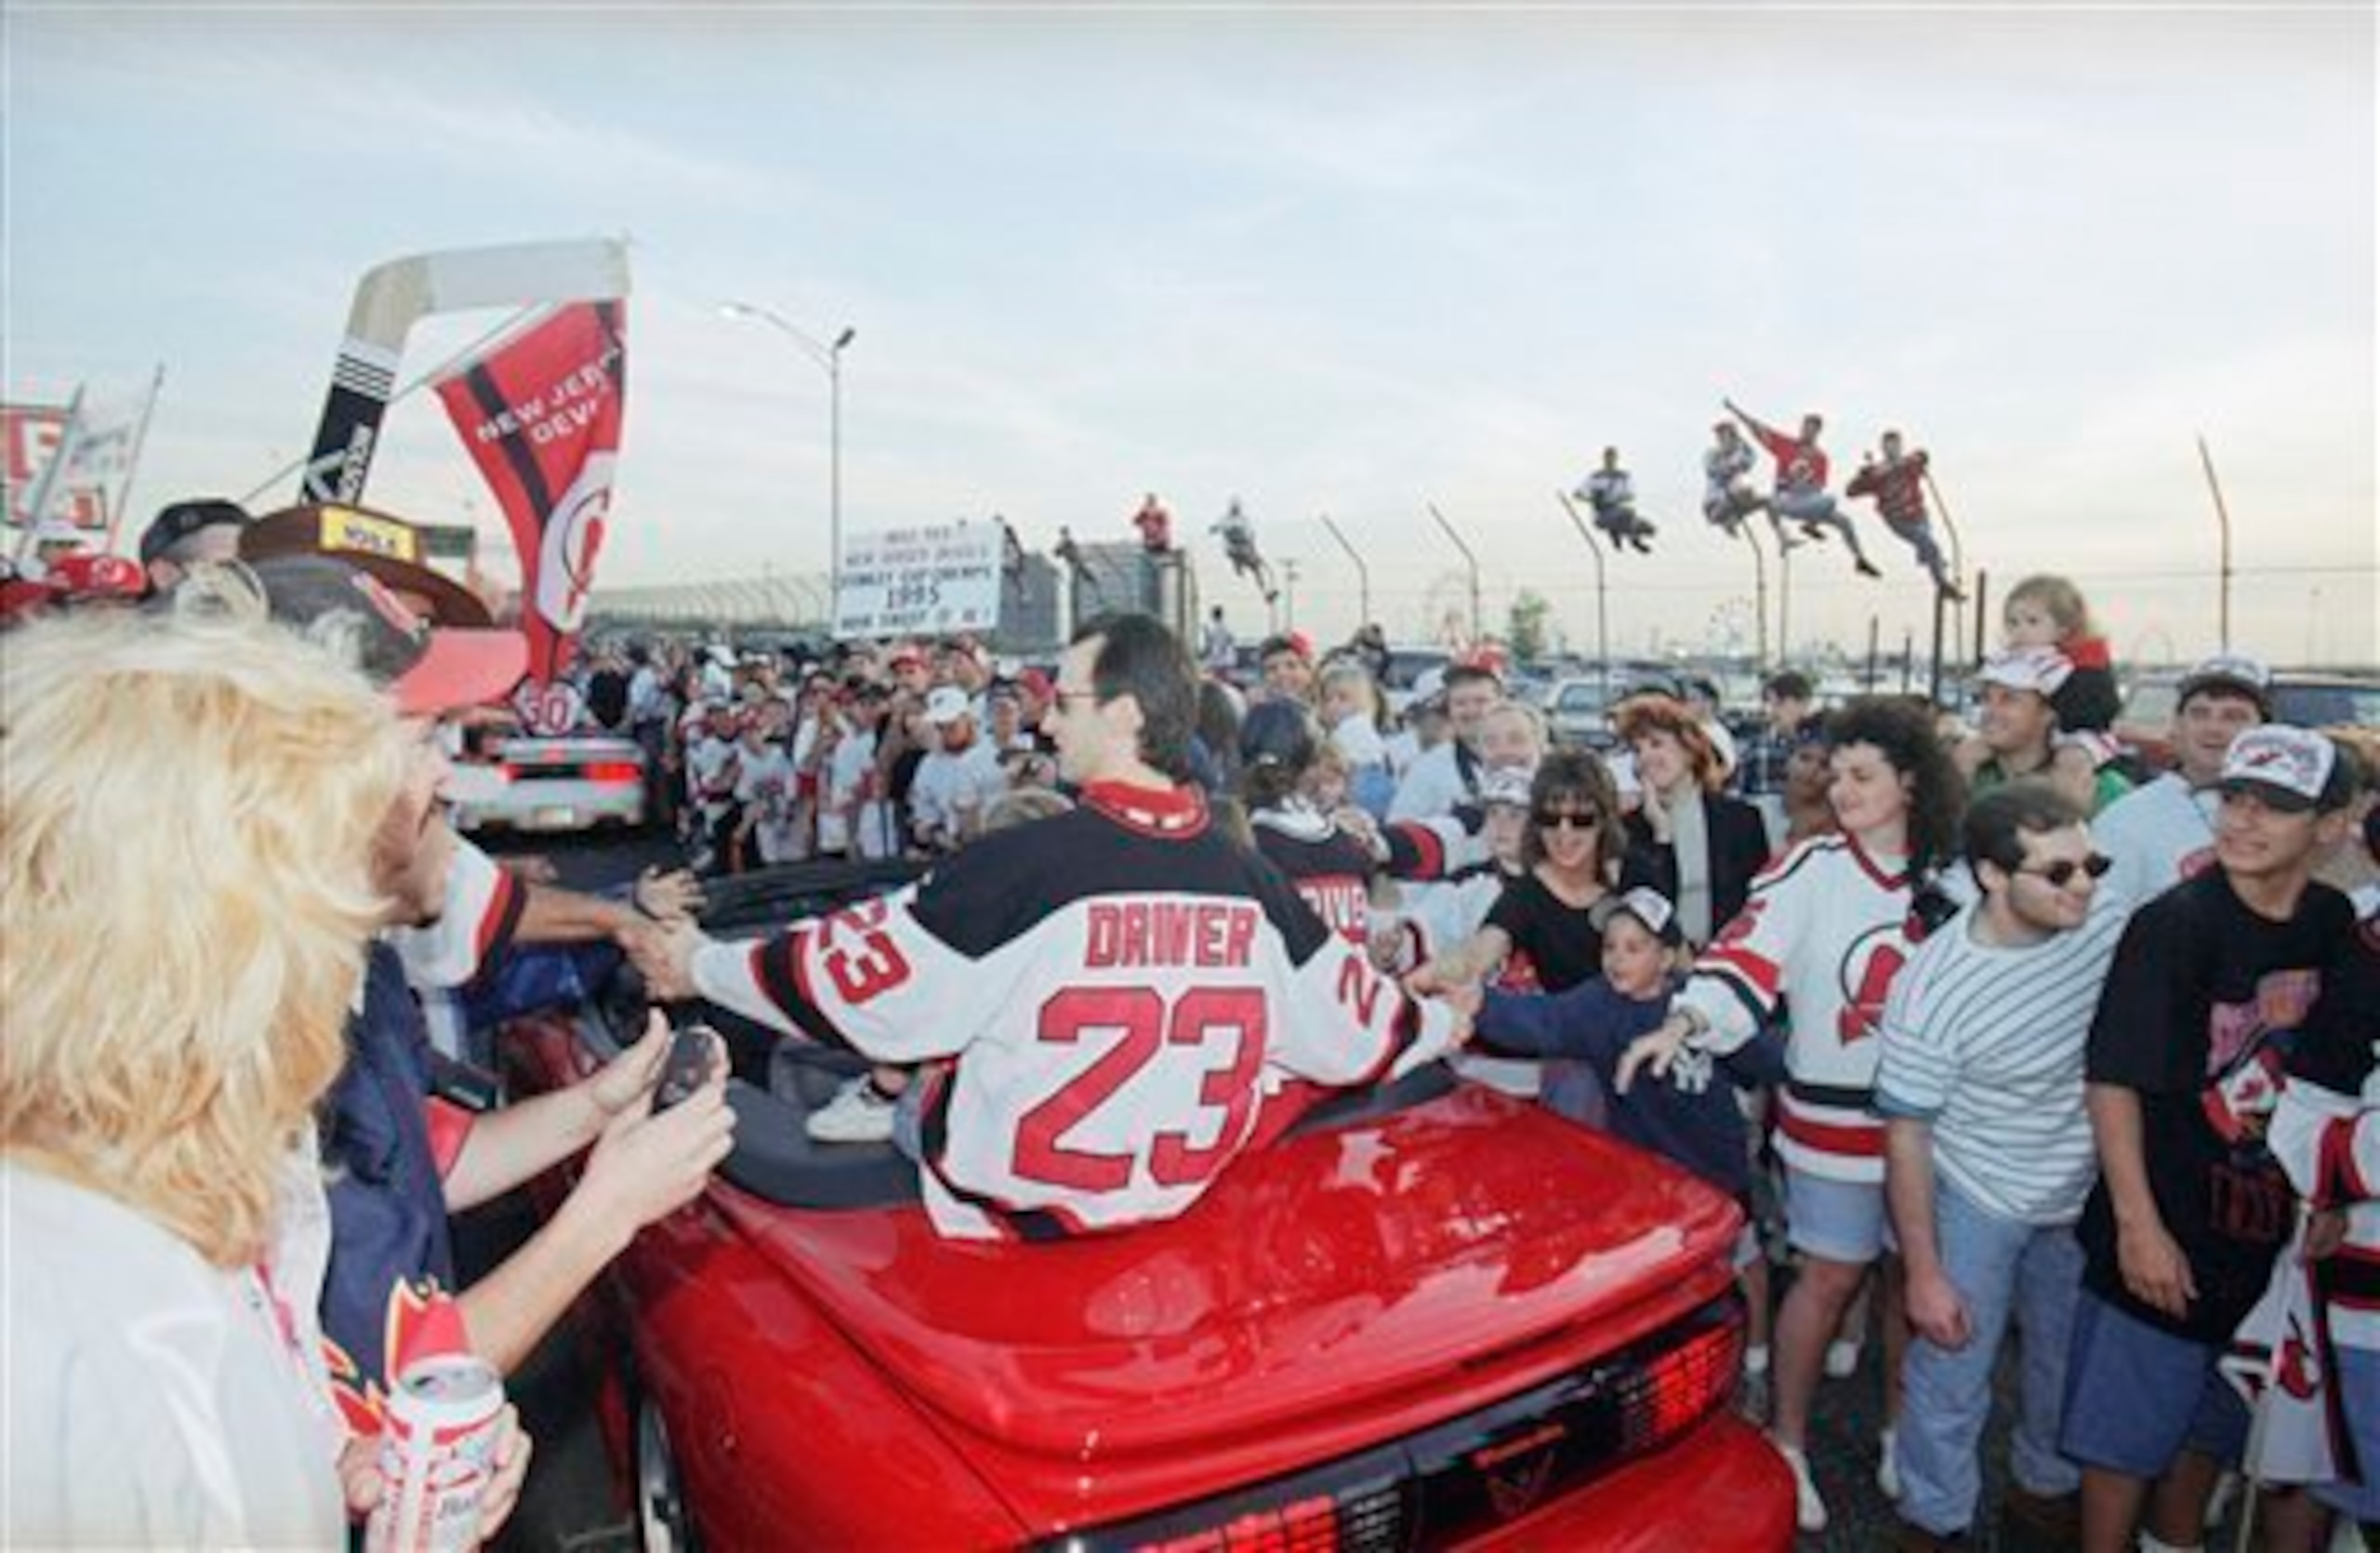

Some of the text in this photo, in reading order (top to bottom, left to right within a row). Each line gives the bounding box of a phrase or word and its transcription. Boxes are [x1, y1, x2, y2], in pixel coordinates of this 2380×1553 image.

[476, 397, 545, 442] NEW
[886, 586, 941, 609] 1995
[1084, 902, 1257, 967] DRIVER
[1011, 986, 1266, 1194] 23
